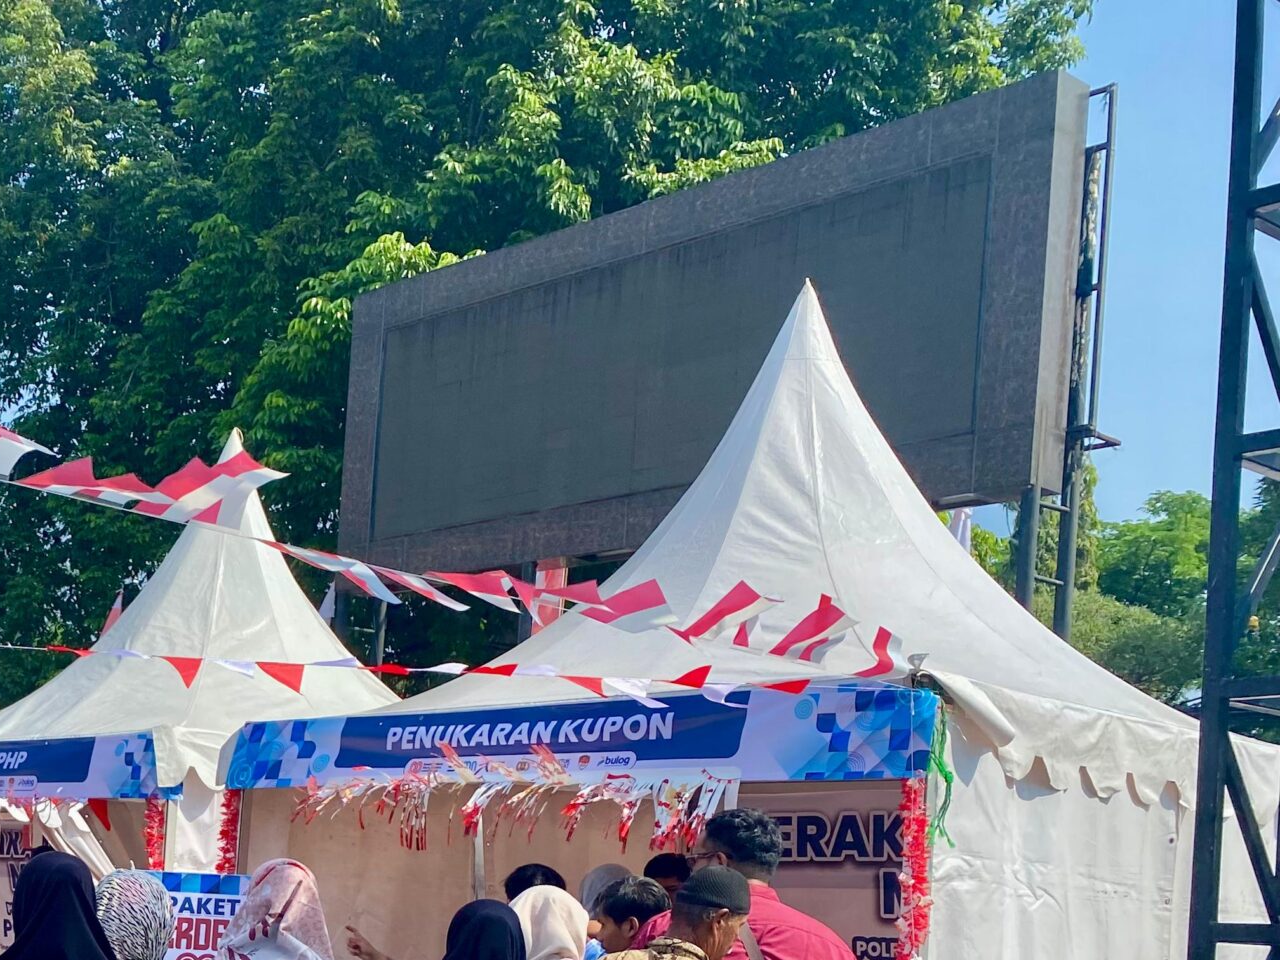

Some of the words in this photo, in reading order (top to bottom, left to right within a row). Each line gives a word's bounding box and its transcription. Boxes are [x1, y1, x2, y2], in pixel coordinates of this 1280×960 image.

[386, 720, 558, 750] PENUKARAN
[558, 711, 675, 744] KUPON
[604, 755, 631, 768] bulog
[769, 814, 905, 858] ERAK
